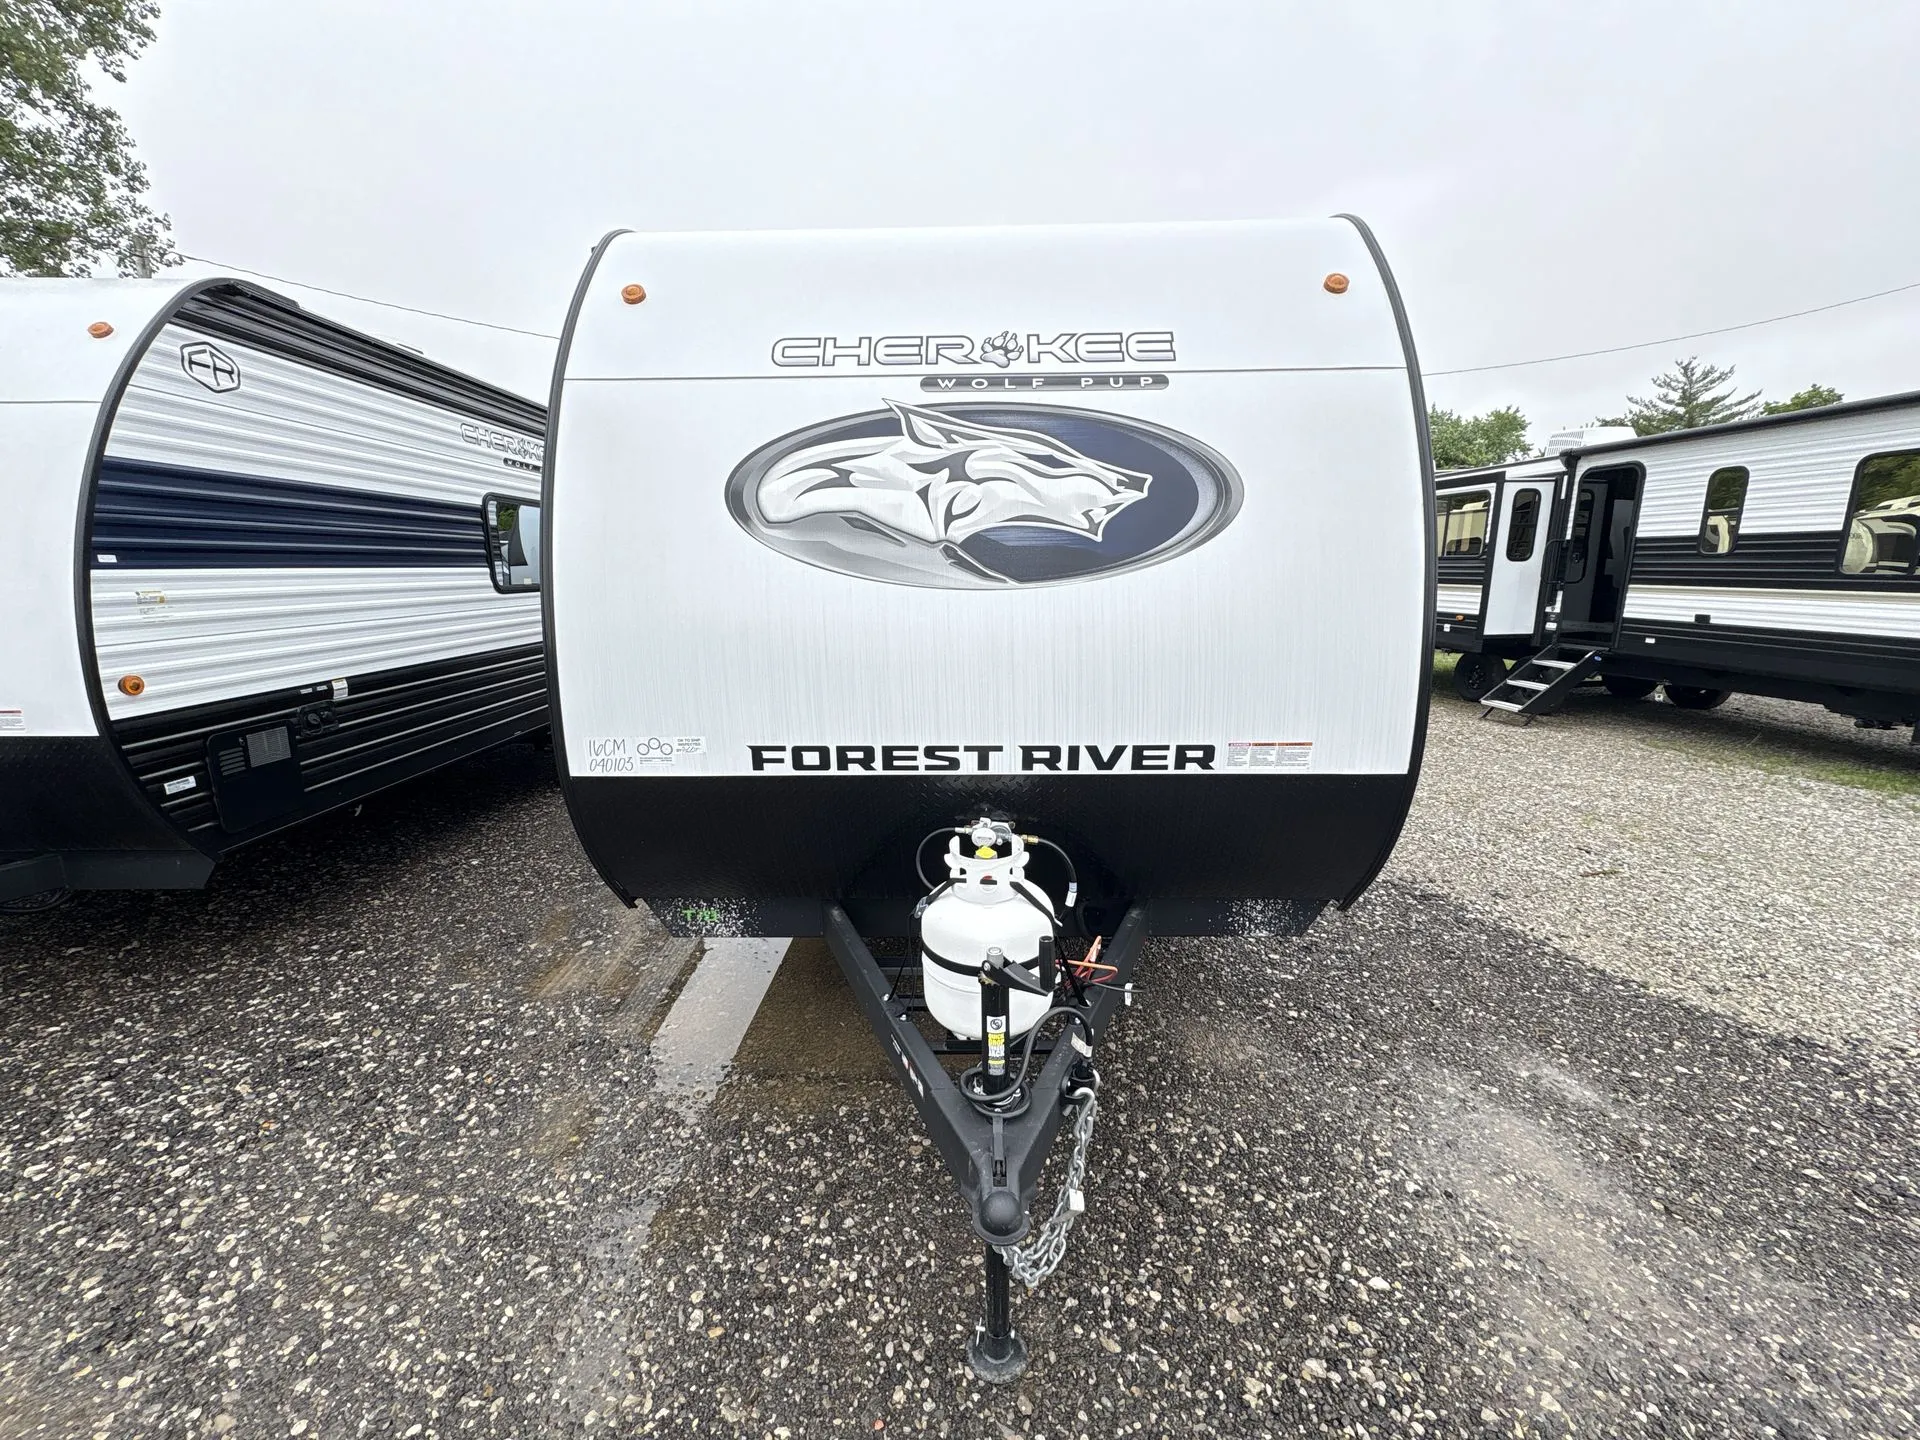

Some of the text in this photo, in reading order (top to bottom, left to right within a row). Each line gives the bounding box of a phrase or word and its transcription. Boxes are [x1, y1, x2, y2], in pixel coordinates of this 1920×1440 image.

[937, 376, 1153, 390] WOLF PUP
[507, 460, 533, 470] WOLF
[746, 745, 1004, 771] FOREST
[1018, 744, 1216, 771] RIVER
